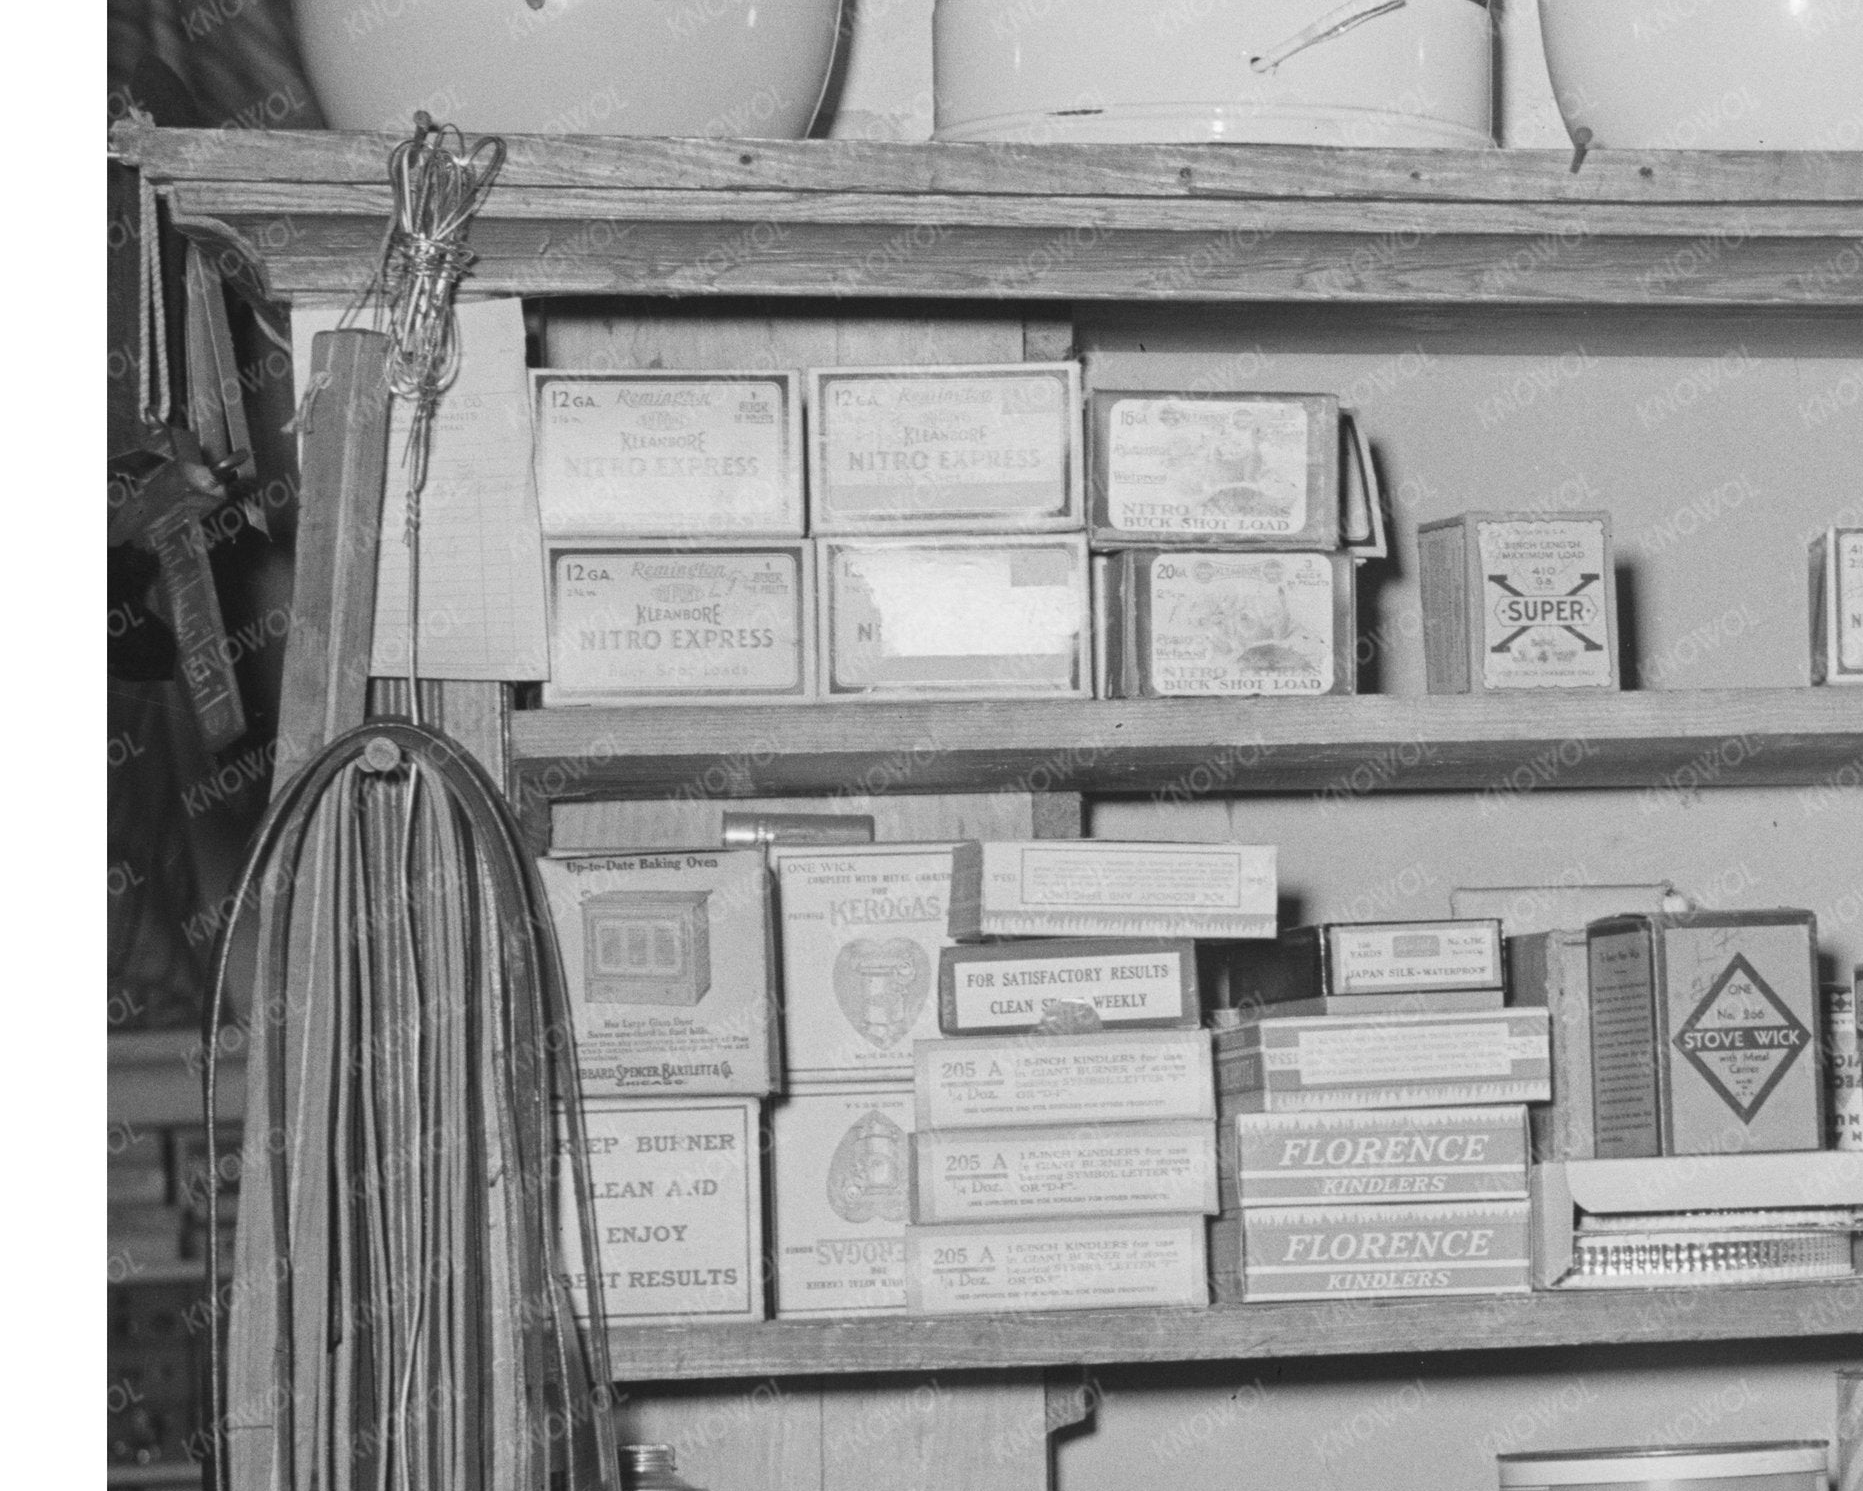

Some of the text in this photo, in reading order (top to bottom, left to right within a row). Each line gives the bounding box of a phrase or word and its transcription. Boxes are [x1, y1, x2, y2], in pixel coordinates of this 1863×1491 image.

[1123, 517, 1290, 531] BUCK SHOT LOAD
[636, 603, 721, 625] KLEANBORE
[1508, 600, 1584, 621] SUPER
[580, 629, 774, 650] NITRO EXPRESS
[1164, 678, 1321, 691] BUCK SHOT LOAD
[566, 857, 718, 876] Up-to-Date Baking Oven
[966, 964, 1168, 988] FOR SATISFACTORY RESULTS
[990, 994, 1148, 1014] CLEAN WEEKLY
[1683, 1029, 1801, 1050] STOVE WICK
[1278, 1136, 1490, 1168] FLORENCE
[1321, 1175, 1446, 1196] KINDLERS
[606, 1224, 688, 1244] ENJOY
[1284, 1229, 1495, 1263] FLORENCE
[628, 1269, 738, 1288] RESULTS
[1326, 1269, 1451, 1290] KINDLERS
